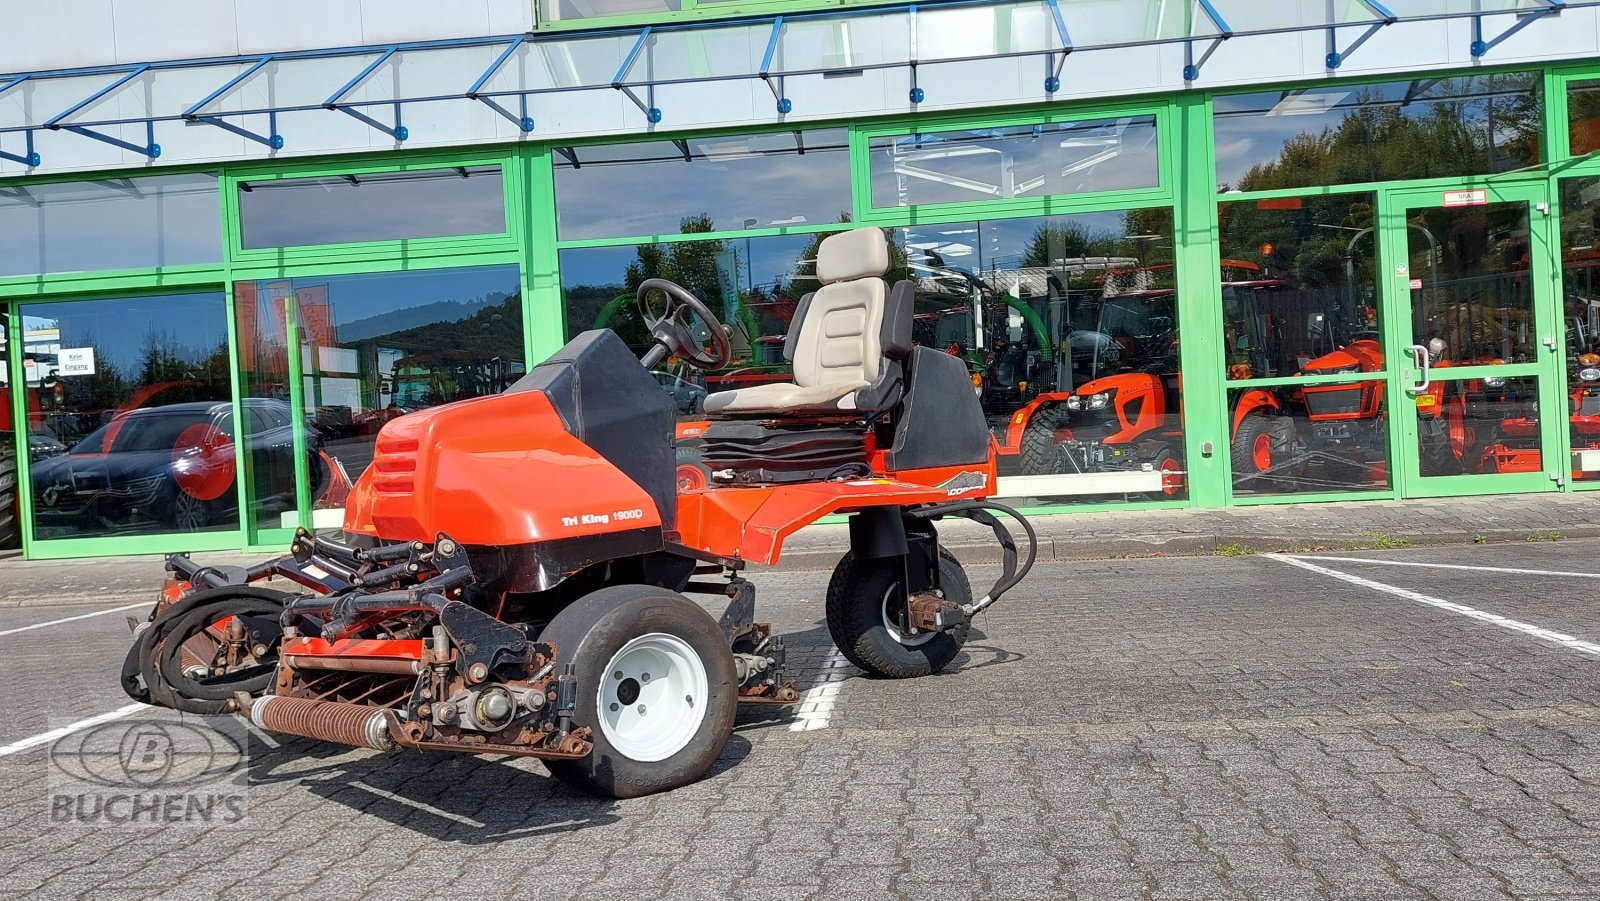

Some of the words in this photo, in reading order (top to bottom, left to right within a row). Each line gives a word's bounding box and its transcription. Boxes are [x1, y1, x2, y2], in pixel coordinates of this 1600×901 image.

[561, 515, 579, 527] Tri
[581, 514, 609, 525] King
[613, 508, 643, 521] 1900D
